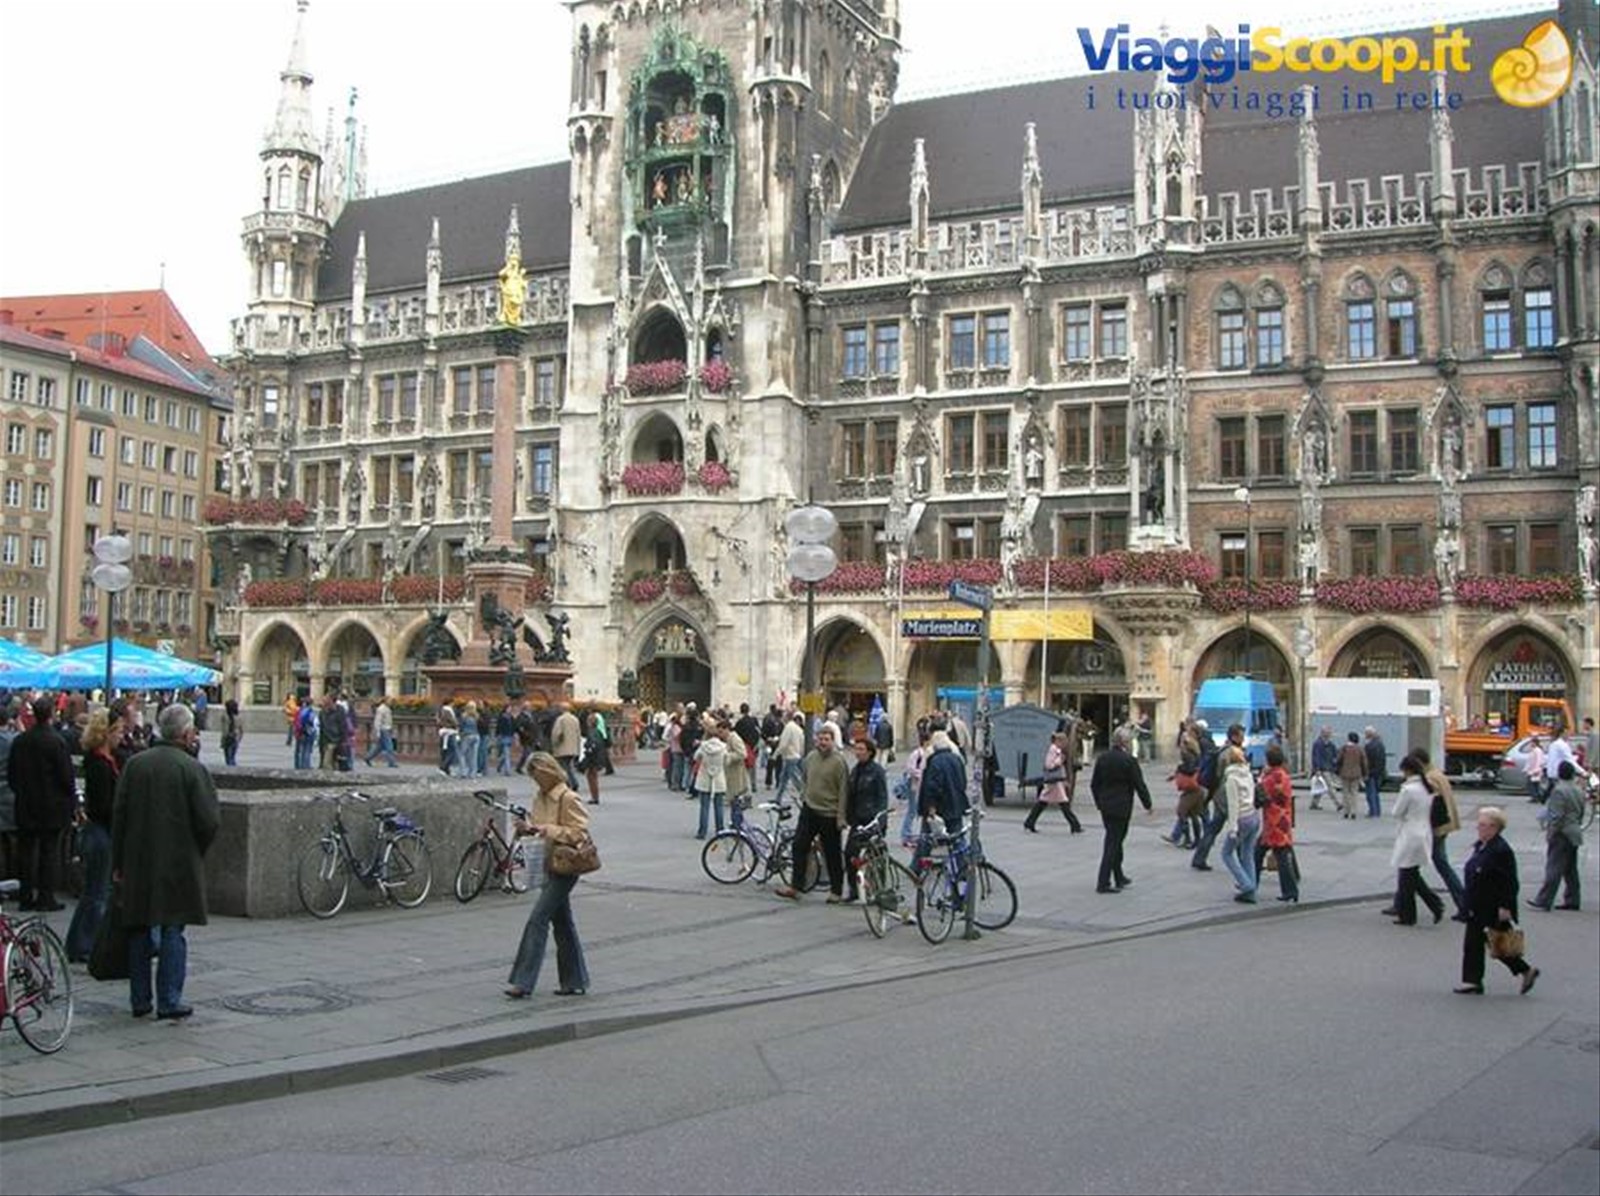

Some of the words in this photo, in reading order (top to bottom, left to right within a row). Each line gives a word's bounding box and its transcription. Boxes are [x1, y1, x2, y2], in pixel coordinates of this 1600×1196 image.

[908, 620, 977, 636] Marienplatz
[1494, 661, 1554, 672] RATHAUS
[1488, 671, 1562, 683] APOTHEKE
